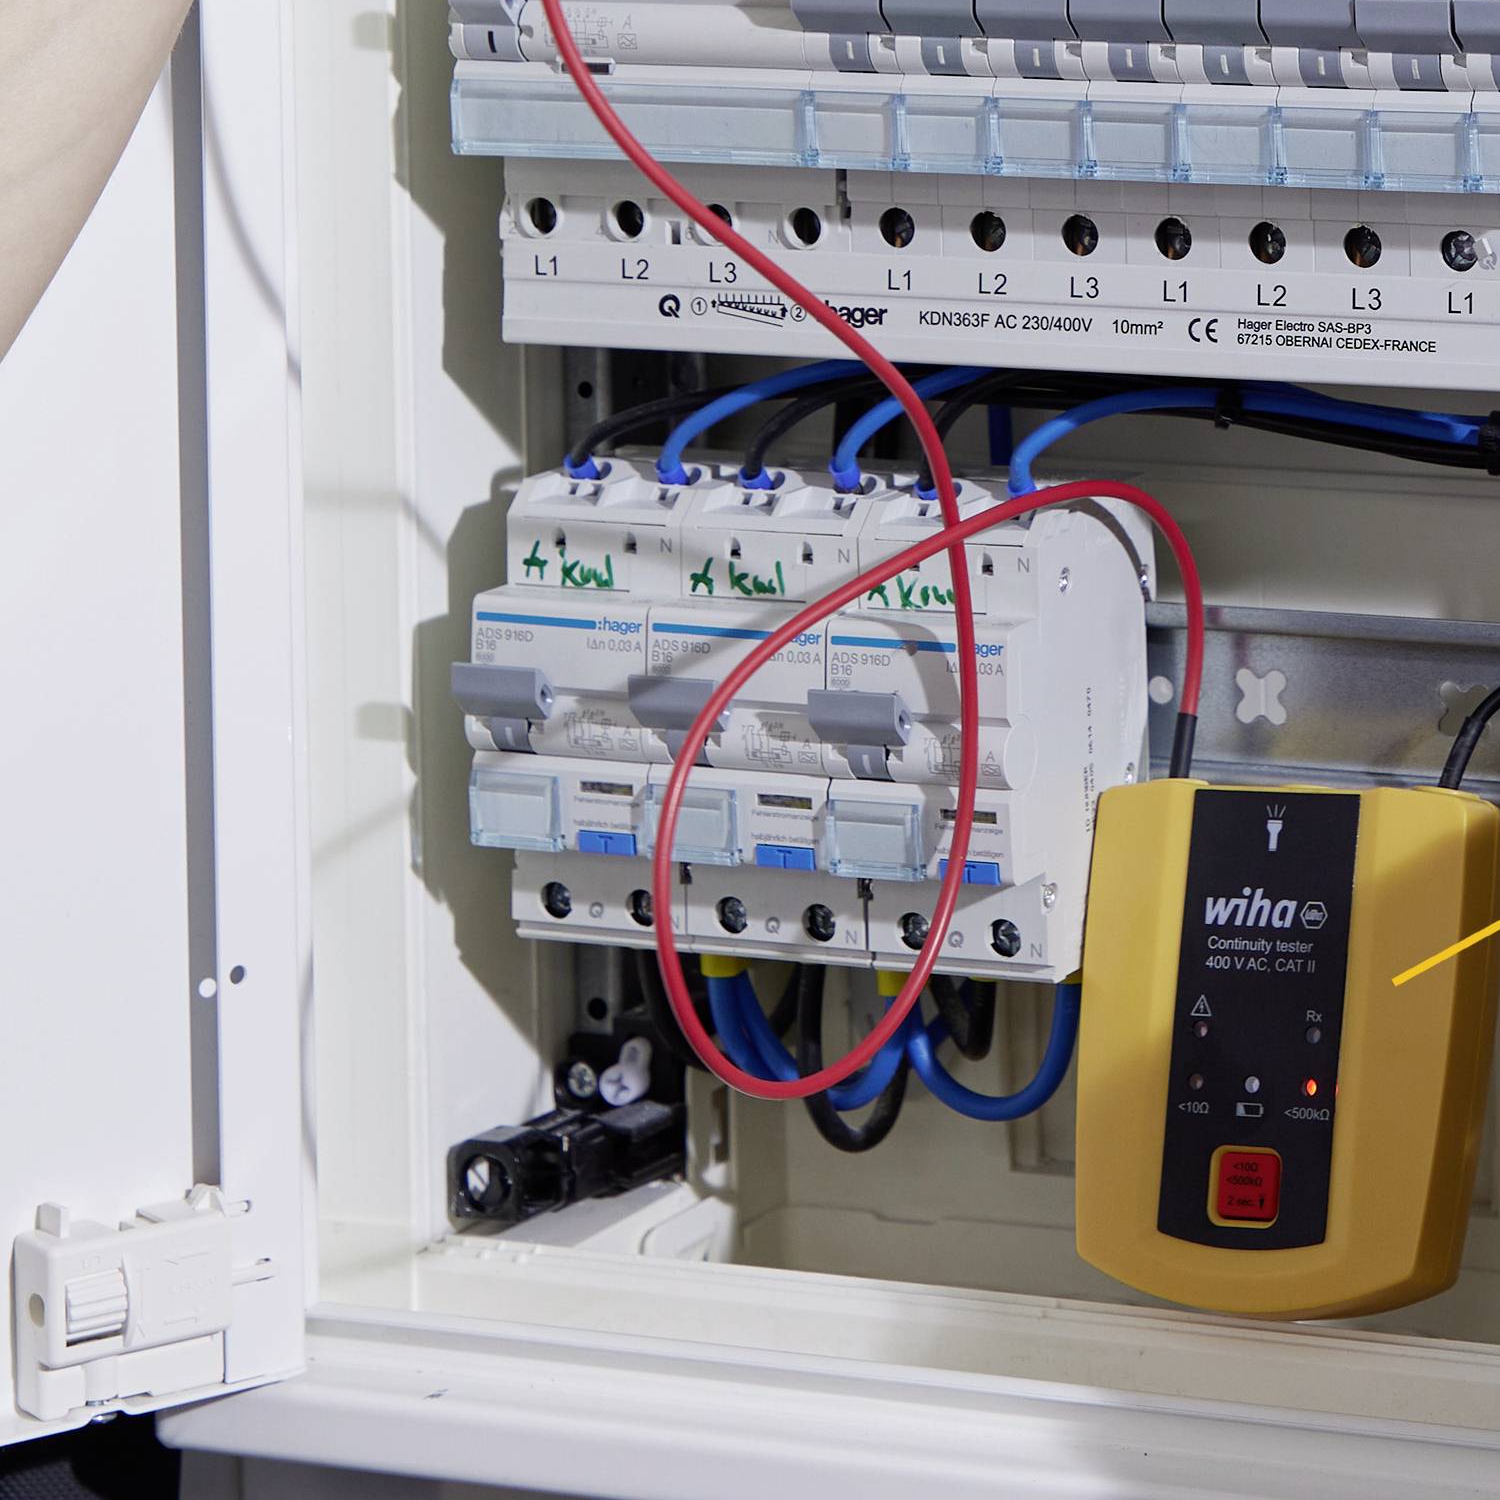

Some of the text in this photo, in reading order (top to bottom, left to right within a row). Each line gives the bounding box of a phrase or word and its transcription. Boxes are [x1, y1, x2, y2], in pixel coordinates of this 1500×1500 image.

[534, 255, 559, 276] L1
[621, 258, 649, 280] L2
[709, 261, 738, 283] L3
[887, 269, 913, 291] L1
[978, 273, 1007, 295] L2
[1070, 277, 1100, 299] L3
[1162, 280, 1188, 302] L1
[1256, 285, 1287, 307] L2
[1351, 288, 1382, 310] L3
[1447, 292, 1473, 314] L1
[919, 311, 990, 327] KDN363F
[995, 313, 1018, 329] AC
[1022, 314, 1092, 333] 230/400V
[1237, 318, 1372, 335] Hager Electro SAS-BP3
[1237, 333, 1437, 353] 67215 OBERNAI CEDEX-FRANCE
[477, 627, 534, 642] ADS 916D
[832, 652, 891, 667] ADS 916D
[1204, 886, 1297, 929] wiha
[1208, 935, 1313, 954] Continuity tester
[1205, 956, 1230, 969] 400
[1233, 957, 1245, 970] V
[1275, 959, 1303, 972] CAT
[1307, 960, 1315, 973] II
[1306, 1010, 1322, 1022] Rx
